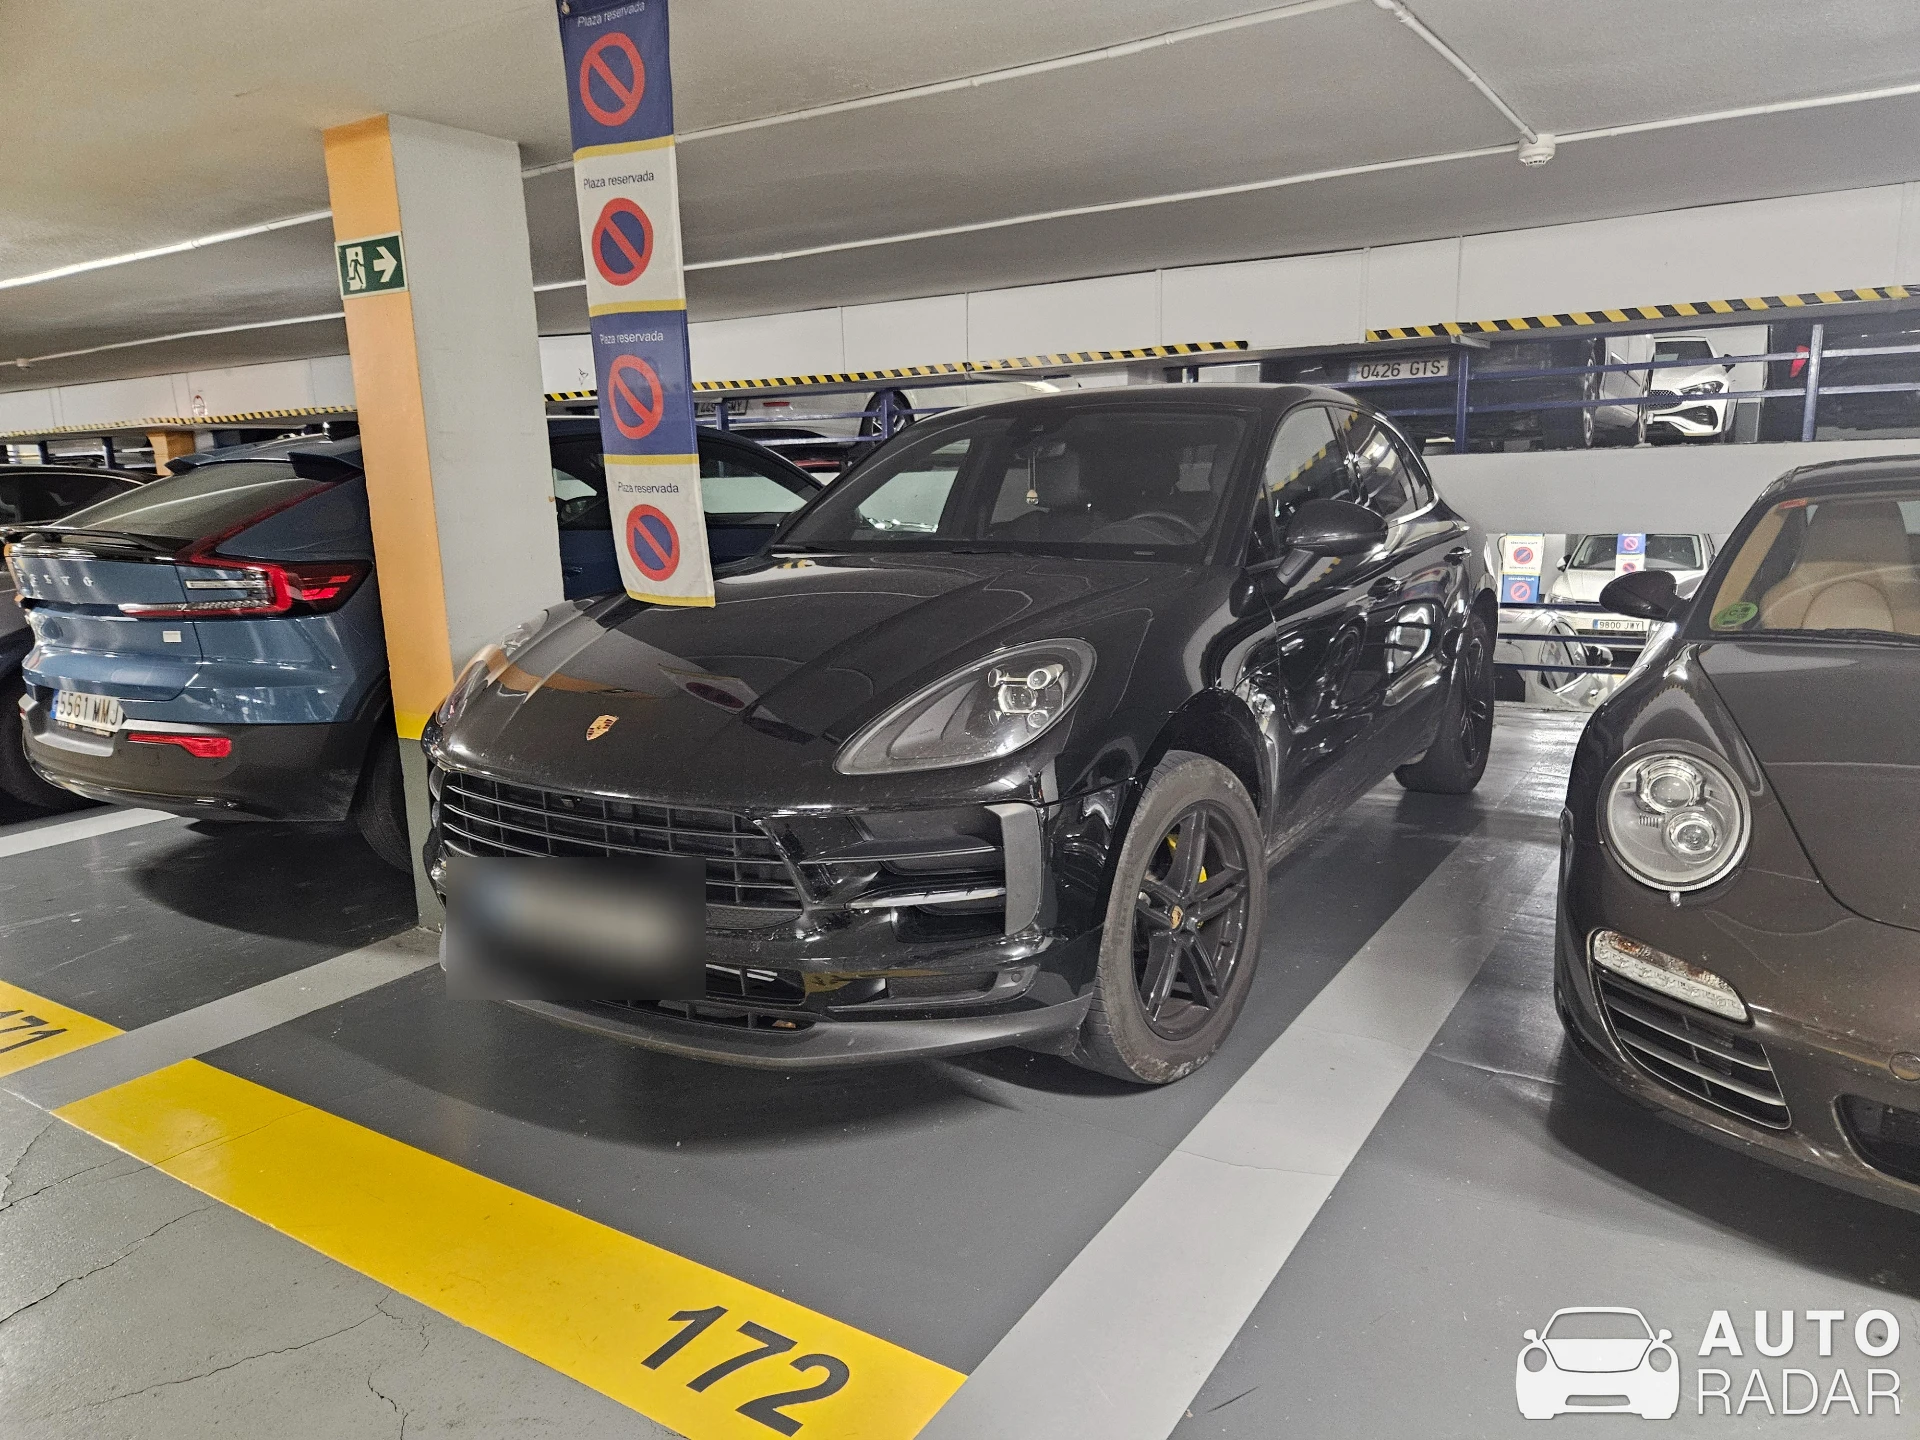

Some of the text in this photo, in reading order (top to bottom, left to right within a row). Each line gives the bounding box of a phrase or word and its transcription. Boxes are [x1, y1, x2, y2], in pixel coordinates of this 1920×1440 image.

[578, 1, 645, 27] Plaza reservada
[583, 170, 654, 190] Plaza reservada
[599, 330, 664, 344] Paza reservada
[1361, 360, 1441, 379] 0426 GTS
[617, 481, 679, 494] Paza reservada
[1599, 621, 1621, 630] 9800
[59, 691, 88, 720] 5561
[0, 1009, 68, 1054] 71
[640, 1305, 850, 1438] 172
